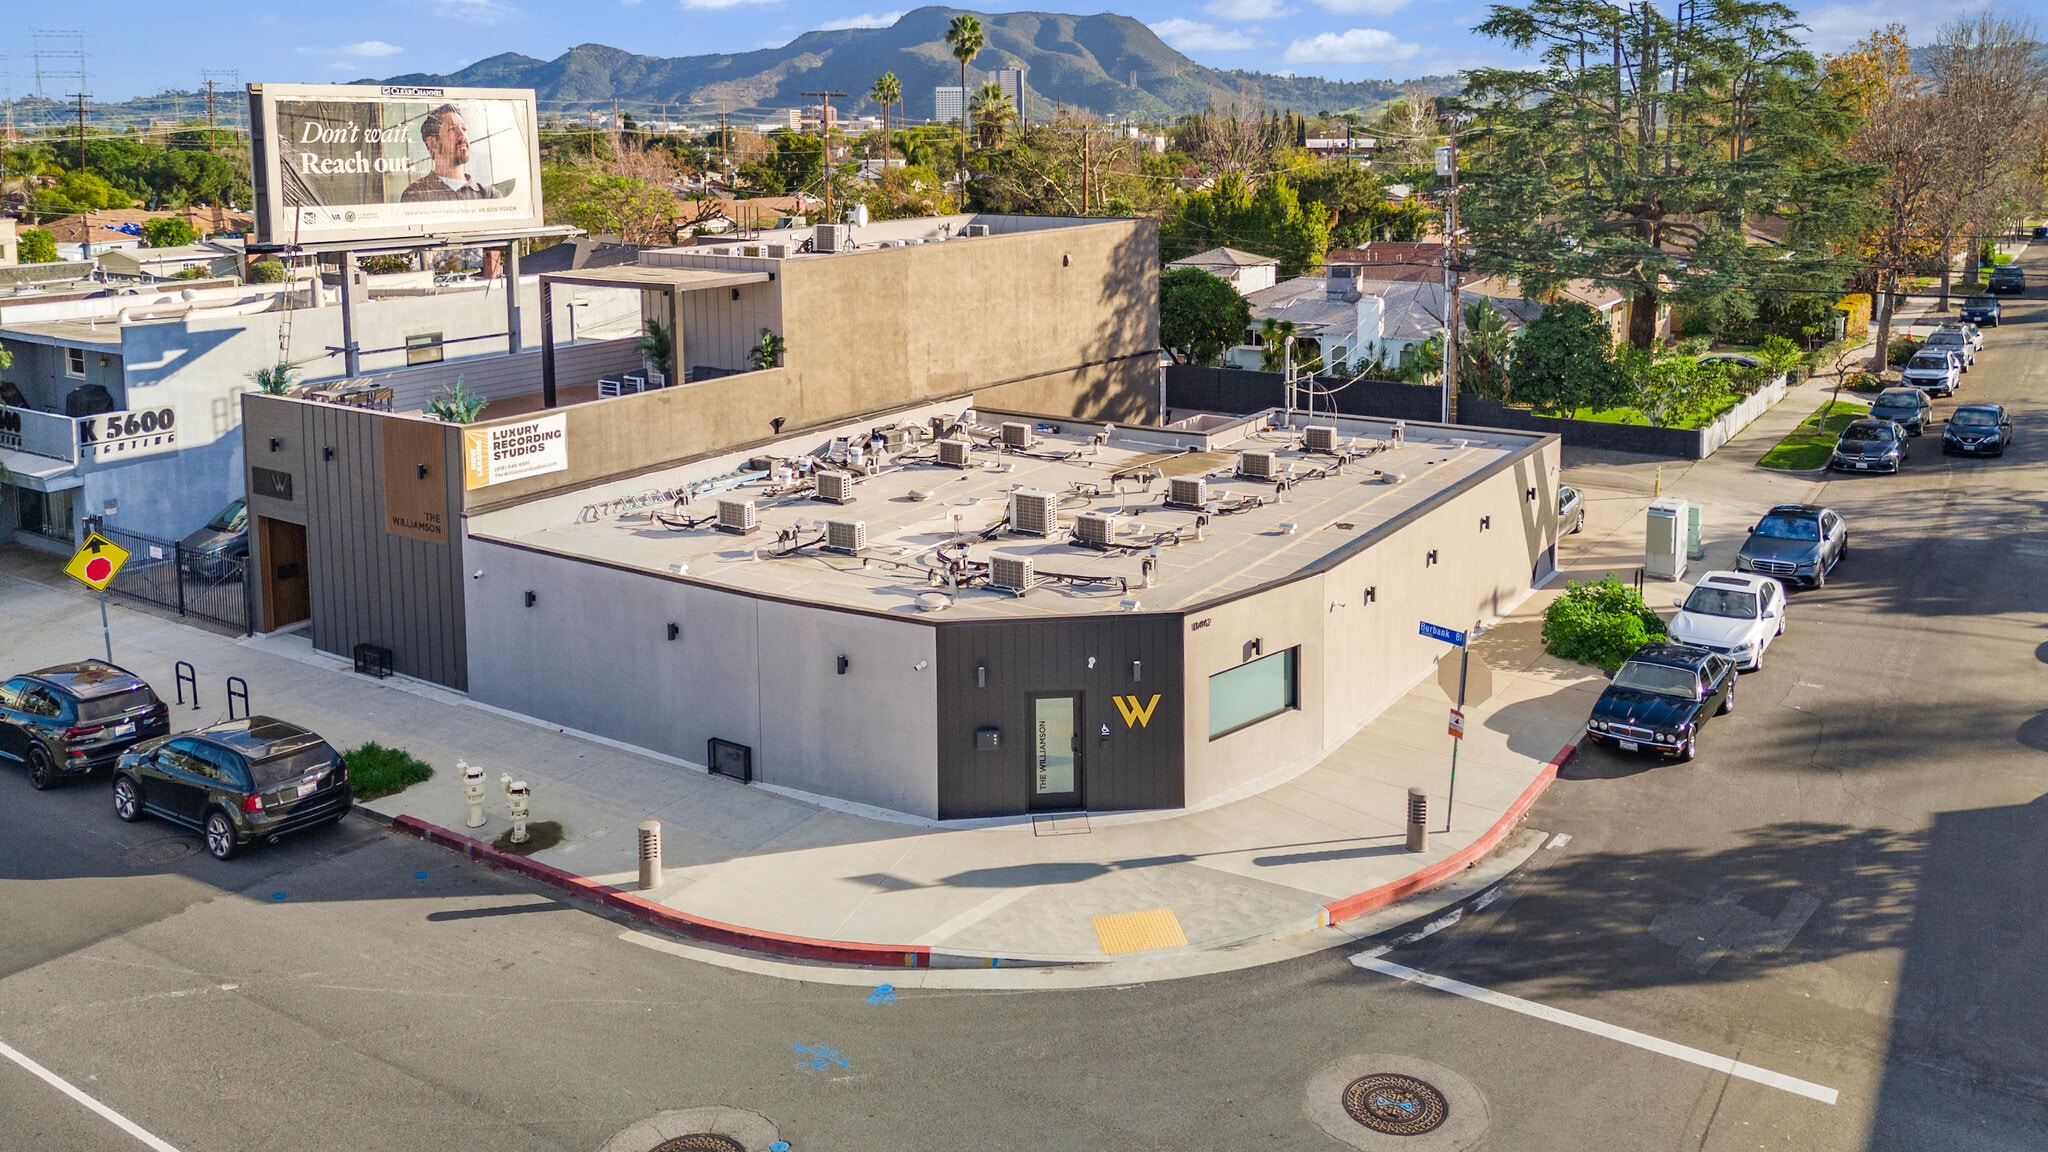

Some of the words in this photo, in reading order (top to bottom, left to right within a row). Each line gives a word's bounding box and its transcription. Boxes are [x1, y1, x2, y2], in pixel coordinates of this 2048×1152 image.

[299, 121, 360, 143] Don't
[363, 123, 413, 143] wait.
[300, 151, 370, 174] Reach
[374, 155, 417, 173] out.
[80, 419, 98, 443] K
[106, 408, 175, 439] 5600
[492, 423, 539, 441] LUXURY
[80, 434, 175, 458] LIGHTING
[493, 429, 562, 451] RECORDING
[493, 443, 545, 461] STUDIOS
[392, 516, 441, 534] WILLIAMSON
[425, 512, 441, 523] THE
[1420, 622, 1449, 638] Burbank
[1455, 632, 1463, 642] Bl
[1112, 694, 1161, 728] W
[1039, 720, 1047, 773] WILLIAMSON
